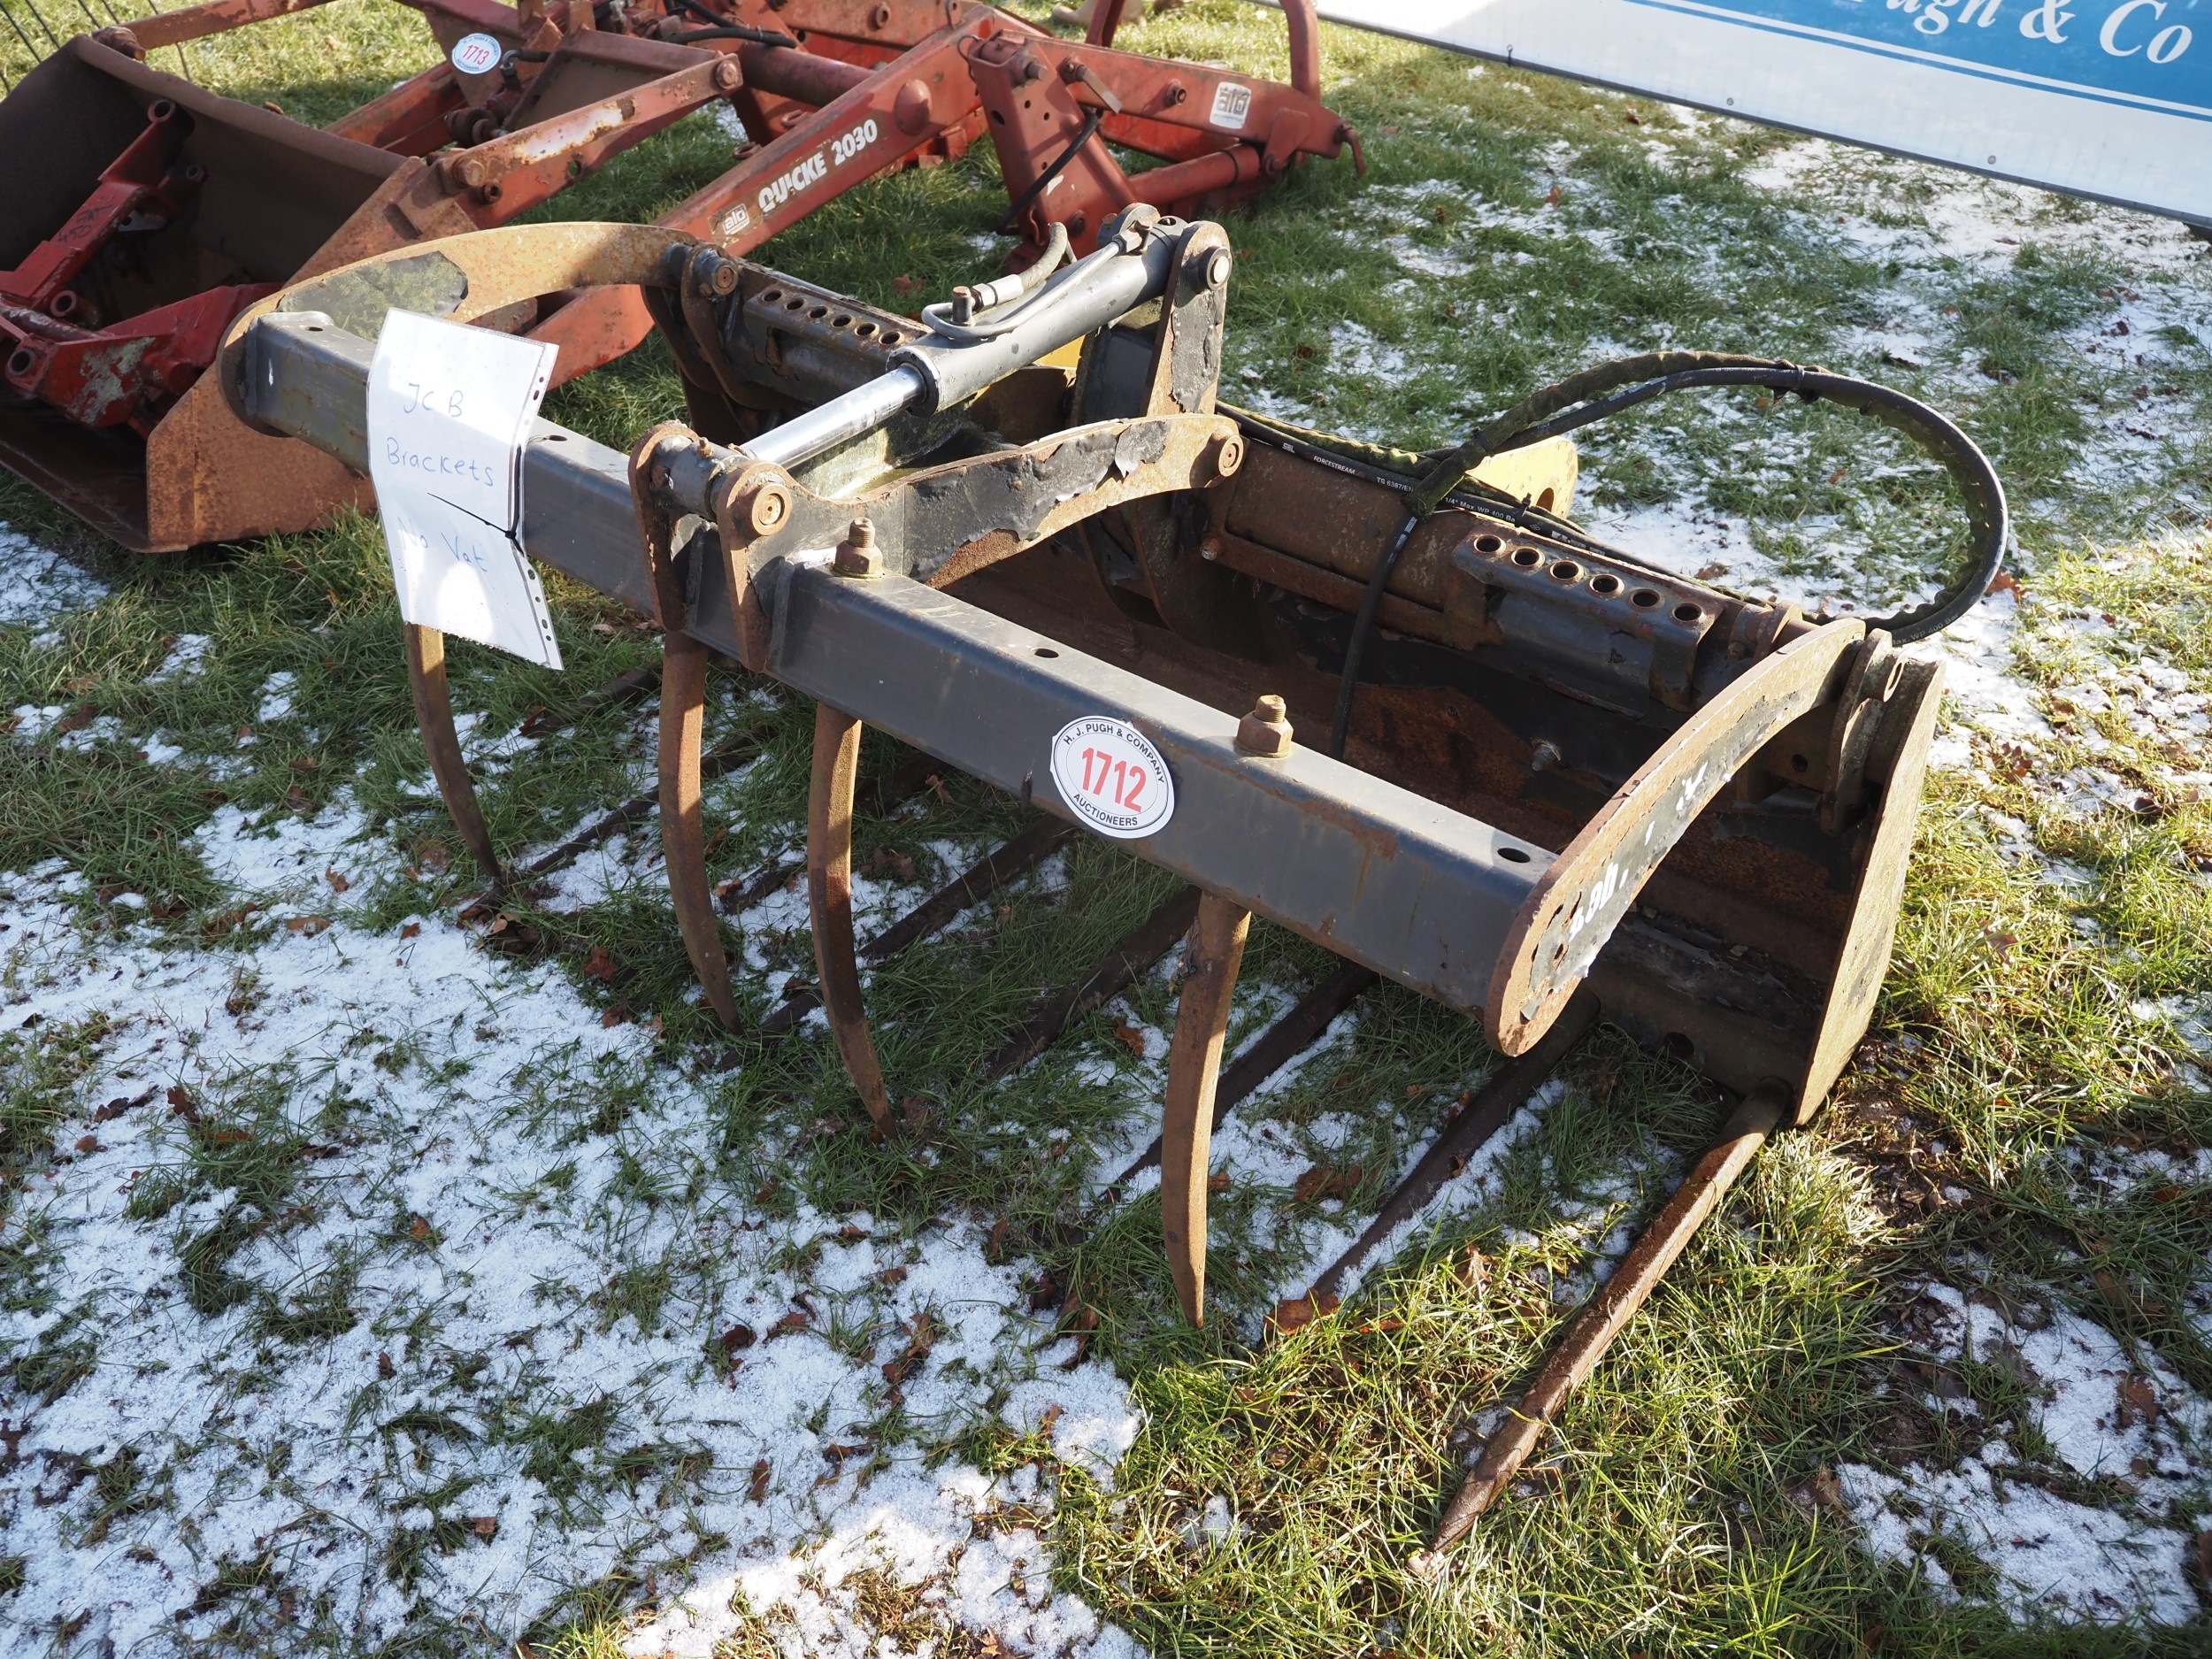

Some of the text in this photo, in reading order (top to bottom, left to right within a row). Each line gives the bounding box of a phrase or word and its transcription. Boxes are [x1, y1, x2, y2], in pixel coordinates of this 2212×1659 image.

[463, 44, 490, 65] 1713
[2019, 0, 2076, 44] &
[2099, 0, 2193, 64] Co
[758, 119, 878, 213] QUICKE 2030
[387, 436, 494, 487] Brackets
[1313, 456, 1356, 475] FORCESTREAM
[1460, 501, 1476, 511] Max.
[1492, 511, 1504, 519] 400
[398, 516, 488, 572] No Vat
[1910, 631, 1925, 641] WP
[1929, 622, 1944, 634] 400
[1946, 613, 1959, 625] Bar
[1064, 723, 1164, 783] H. J. PUGH & COMPANY
[1081, 747, 1147, 813] 1712
[1073, 794, 1139, 826] AUCTIONEERS
